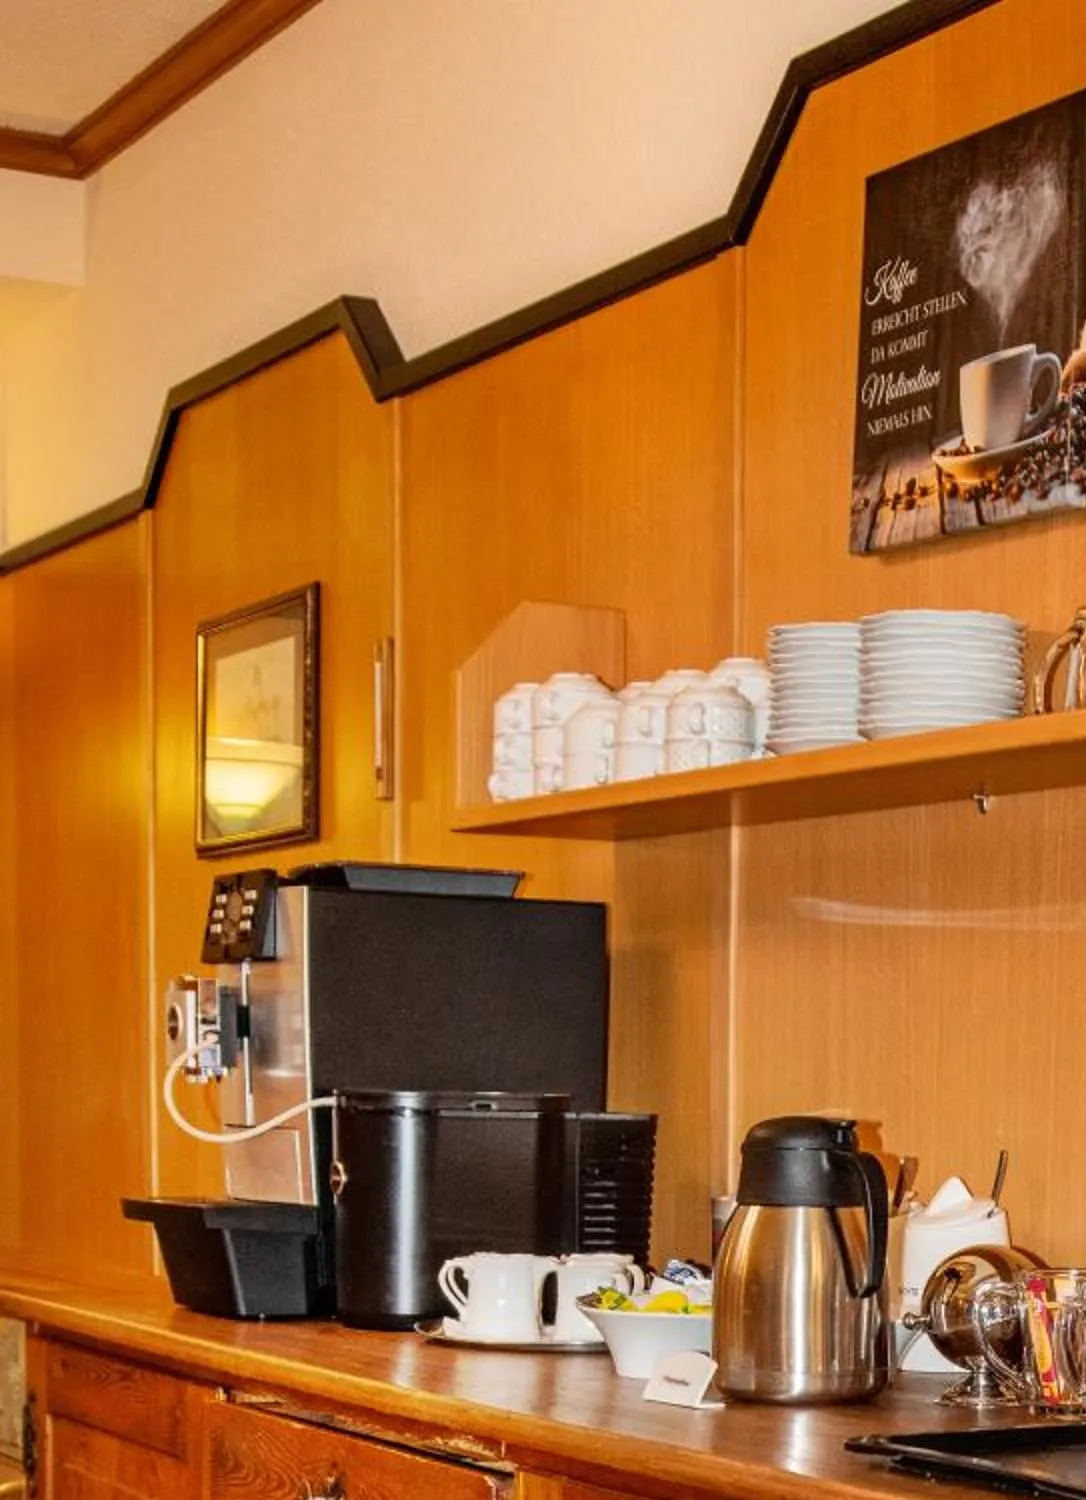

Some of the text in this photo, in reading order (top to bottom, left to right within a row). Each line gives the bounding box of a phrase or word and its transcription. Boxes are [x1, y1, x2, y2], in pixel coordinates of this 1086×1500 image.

[870, 303, 921, 336] ERREICHT
[871, 330, 928, 364] DA KOMMT
[861, 364, 941, 409] Motivation
[867, 409, 909, 437] NIEMALS
